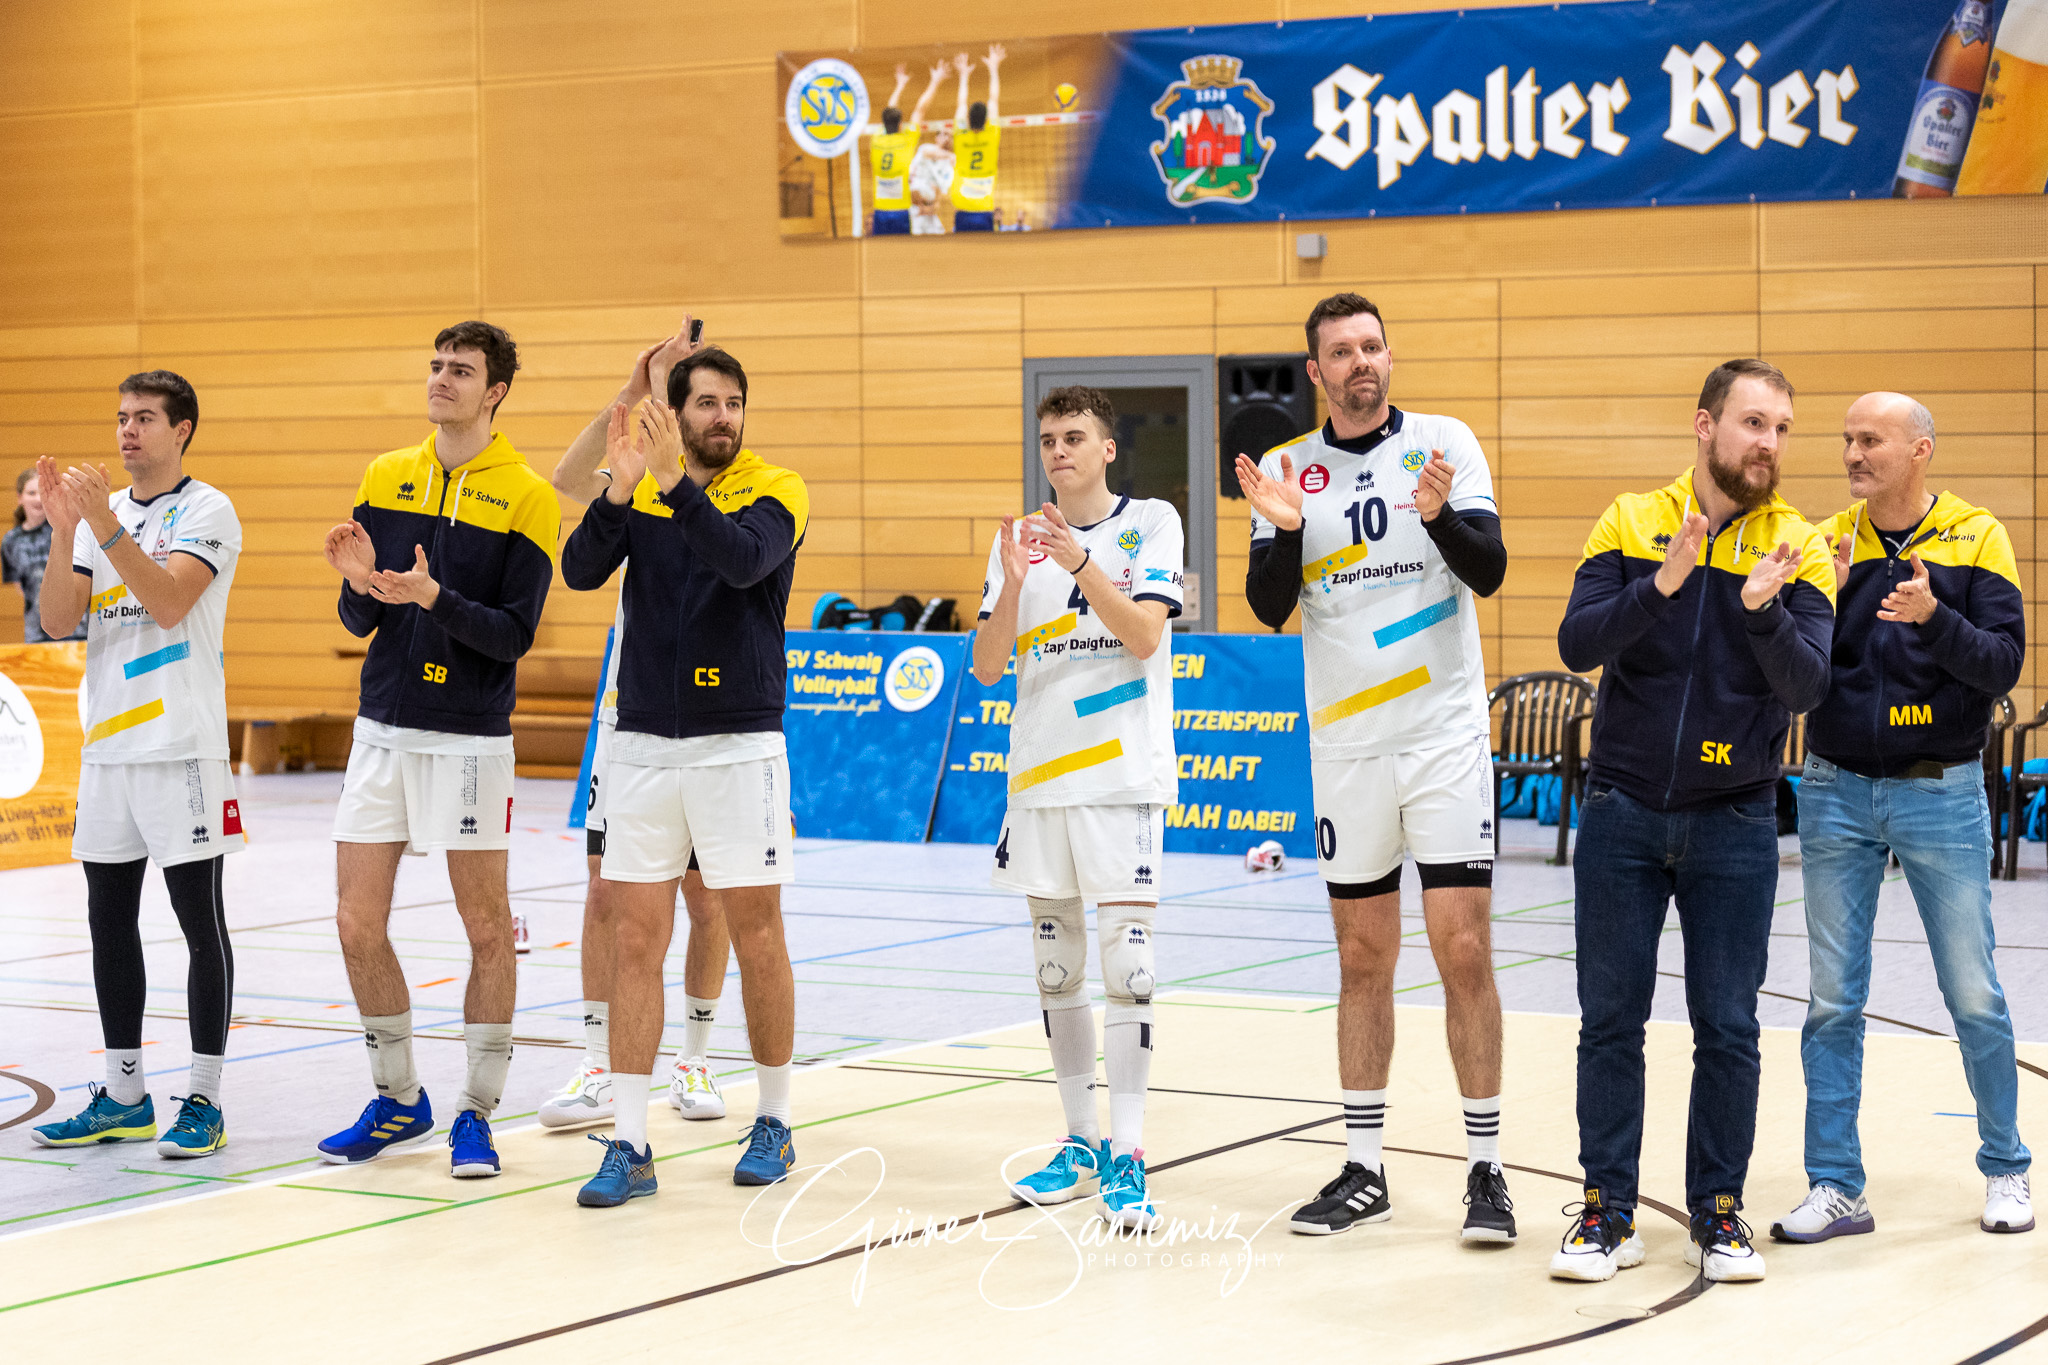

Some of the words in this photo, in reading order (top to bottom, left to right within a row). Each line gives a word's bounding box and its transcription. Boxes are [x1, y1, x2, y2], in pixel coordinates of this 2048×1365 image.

[1305, 62, 1631, 191] Spalter
[1660, 40, 1860, 156] Bier
[462, 487, 474, 498] SV
[476, 491, 510, 511] Schwaig
[1394, 502, 1416, 511] Heinz
[1344, 496, 1388, 546] 10
[1067, 581, 1091, 616] 4
[423, 662, 448, 684] SB
[786, 650, 811, 669] SV
[813, 651, 883, 675] Schwaig
[694, 667, 720, 687] CS
[793, 674, 878, 698] Volleyball
[1889, 704, 1933, 726] MM
[1700, 740, 1732, 766] SK
[1176, 753, 1262, 782] CHAFT
[587, 774, 599, 812] 6
[1163, 803, 1222, 829] NAH
[995, 827, 1010, 869] 4
[1315, 815, 1337, 861] 10
[1134, 877, 1153, 885] errea
